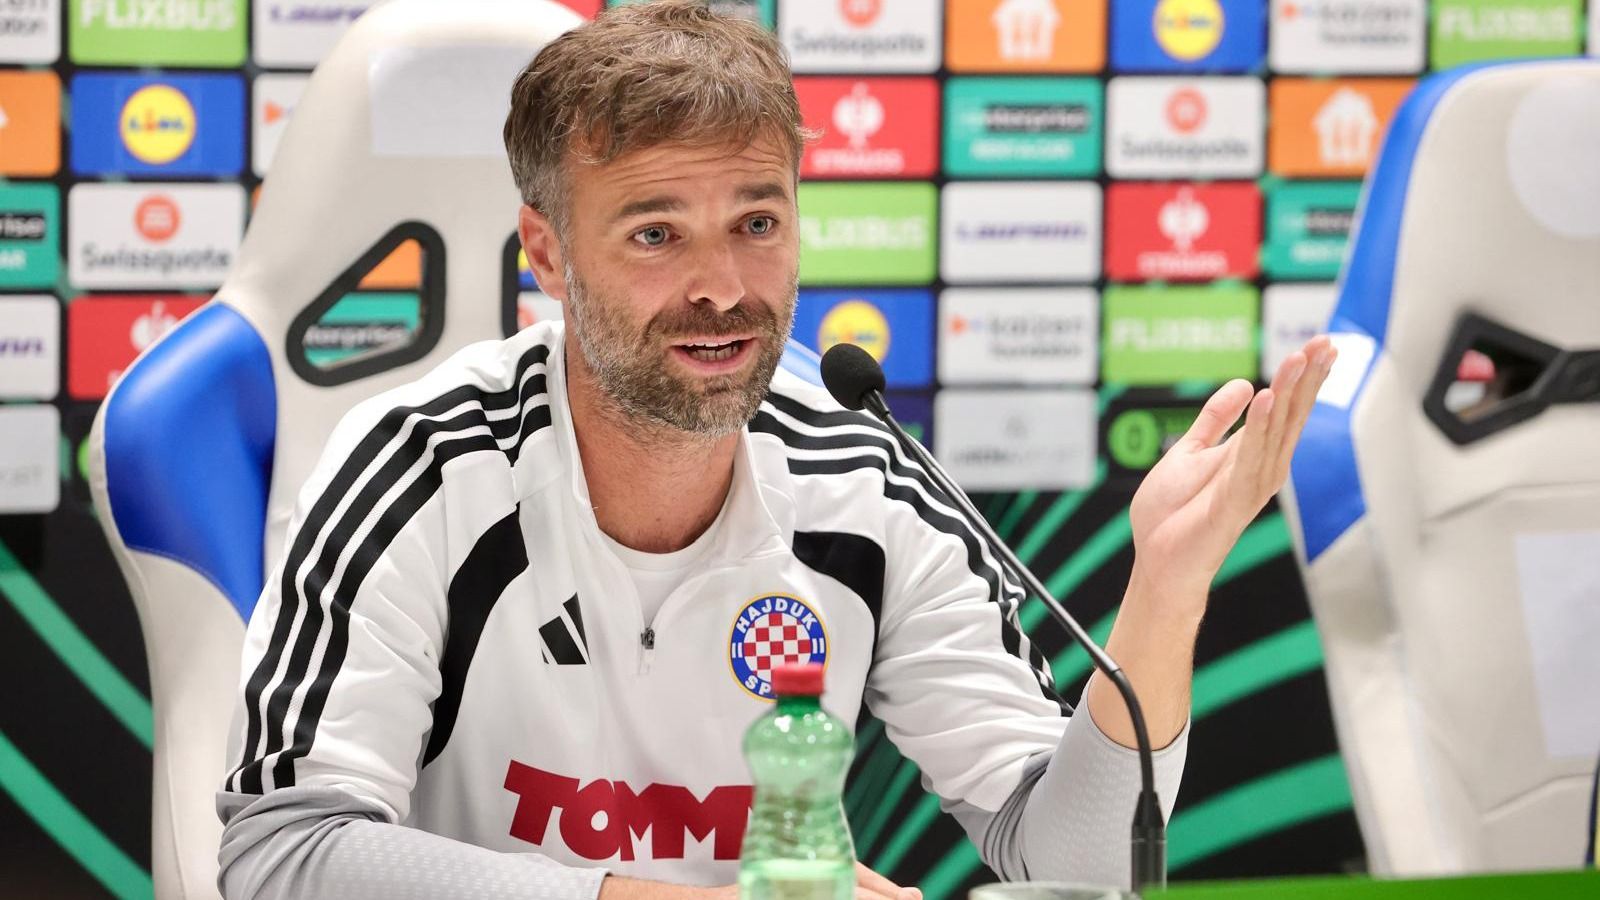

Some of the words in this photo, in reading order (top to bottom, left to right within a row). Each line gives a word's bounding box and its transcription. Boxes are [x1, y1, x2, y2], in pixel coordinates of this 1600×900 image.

[80, 0, 236, 30] FLIXBUS
[1438, 6, 1573, 41] FLIXBUS
[82, 243, 233, 276] Swissquote
[1110, 317, 1248, 350] FLIXBUS
[735, 597, 818, 634] HAJDUK
[744, 674, 772, 696] SP
[503, 759, 756, 861] TOMM
